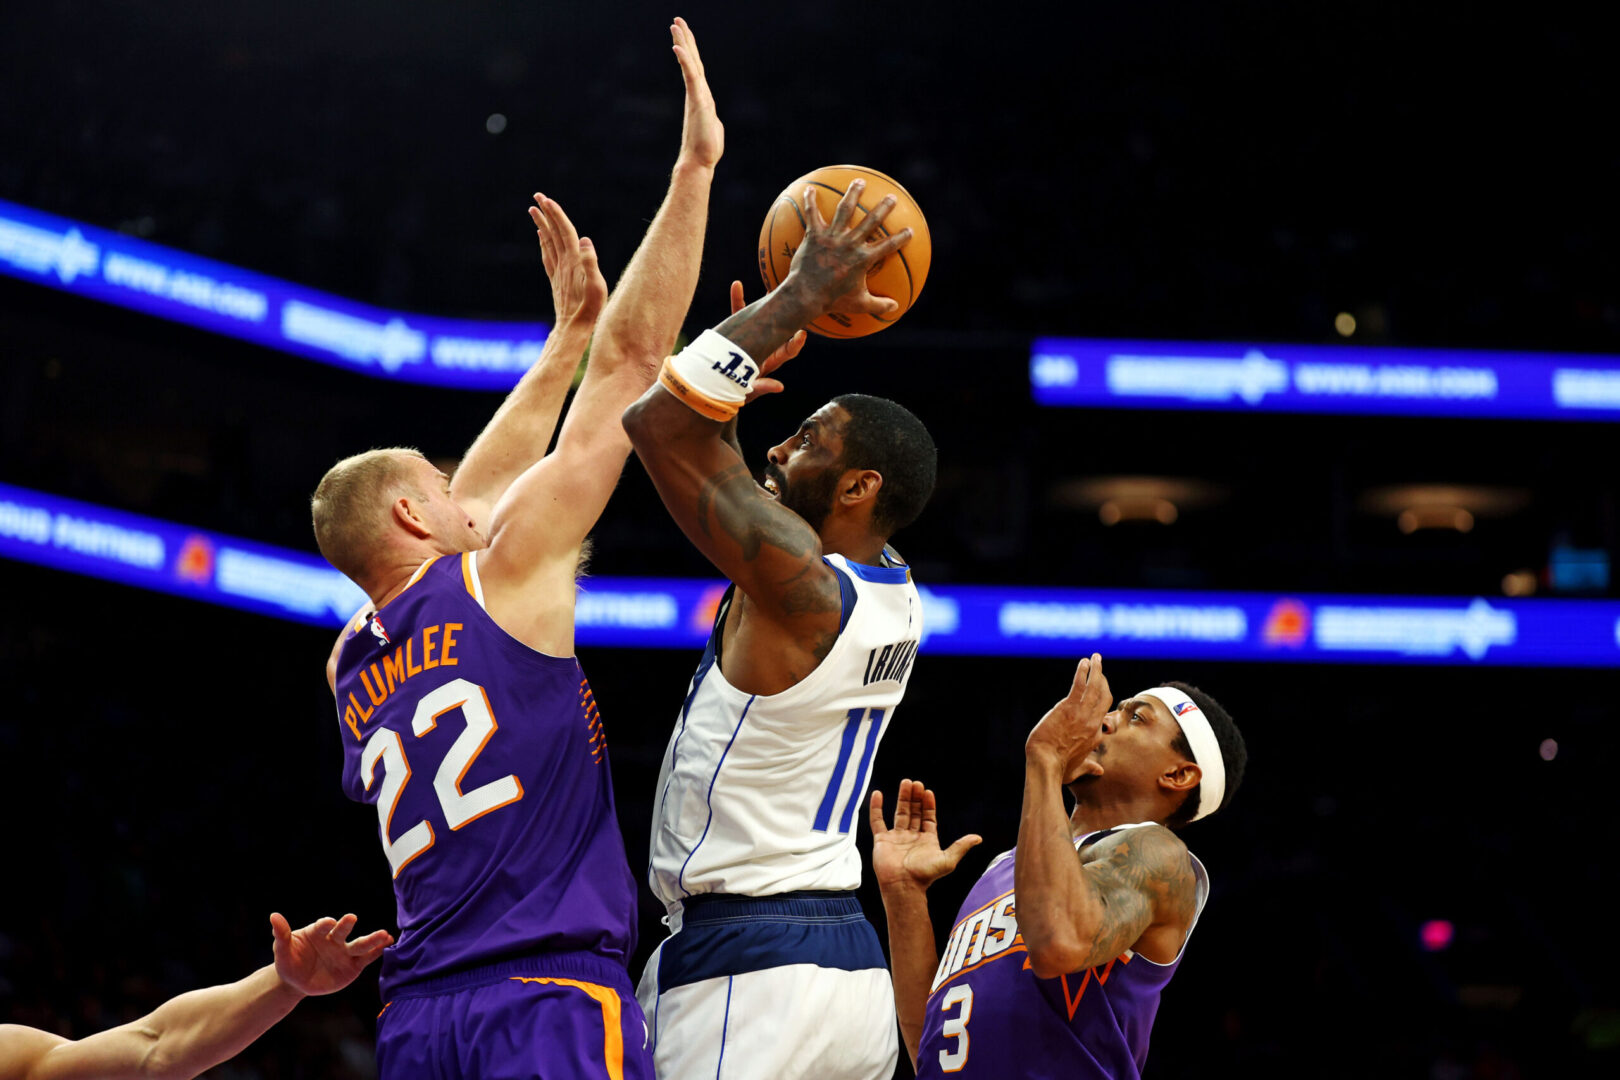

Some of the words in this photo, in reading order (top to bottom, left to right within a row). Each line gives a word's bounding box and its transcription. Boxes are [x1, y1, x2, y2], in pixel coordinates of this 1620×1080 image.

[344, 623, 463, 741] PLUMLEE
[360, 678, 525, 879] 22
[810, 707, 886, 834] 11
[931, 894, 1018, 993] UNS
[938, 983, 974, 1073] 3
